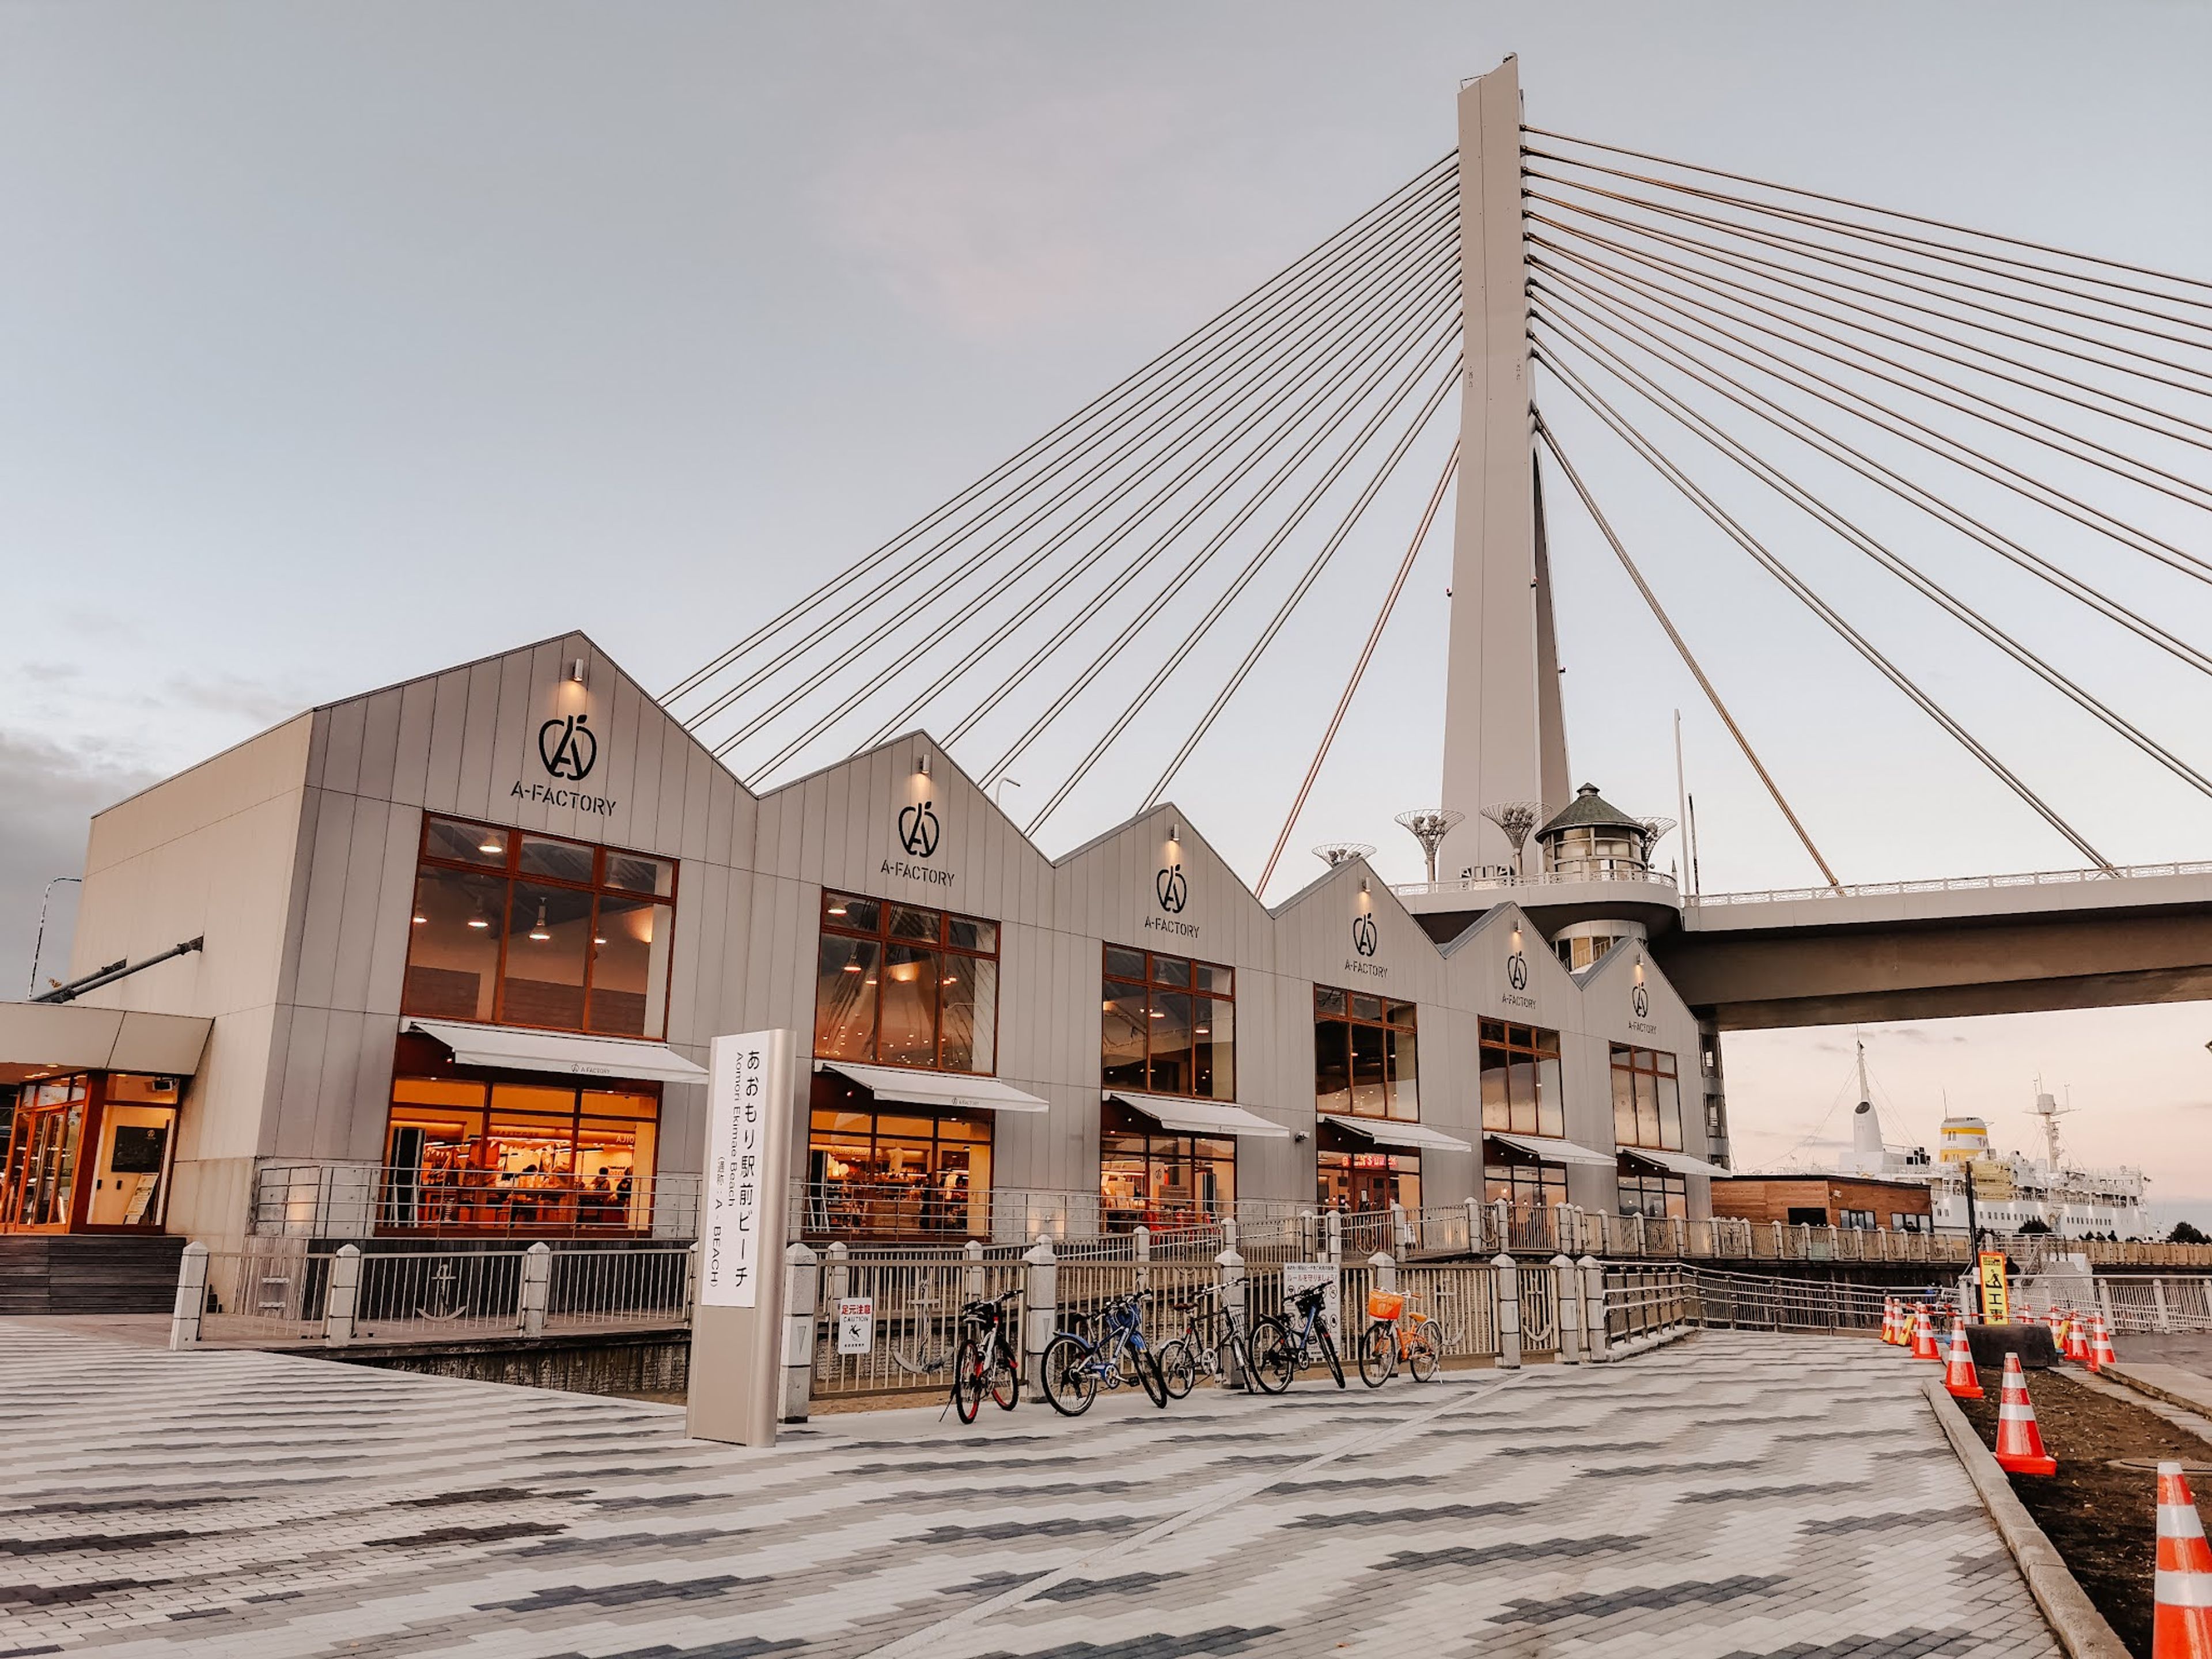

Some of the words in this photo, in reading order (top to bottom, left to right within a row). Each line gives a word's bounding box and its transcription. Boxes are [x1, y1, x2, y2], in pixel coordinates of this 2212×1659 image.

[510, 781, 616, 816] A-FACTORY
[880, 859, 955, 887] A-FACTORY
[1144, 916, 1200, 938] A-FACTORY
[1344, 959, 1388, 978] A-FACTORY
[1502, 993, 1536, 1009] A-FACTORY
[734, 1052, 744, 1101] Aomori
[731, 1106, 741, 1157] Ekimae
[735, 1050, 760, 1287] あおもり駅前ビーチ
[728, 1162, 737, 1207] Beach
[842, 1305, 871, 1315] 足元注意
